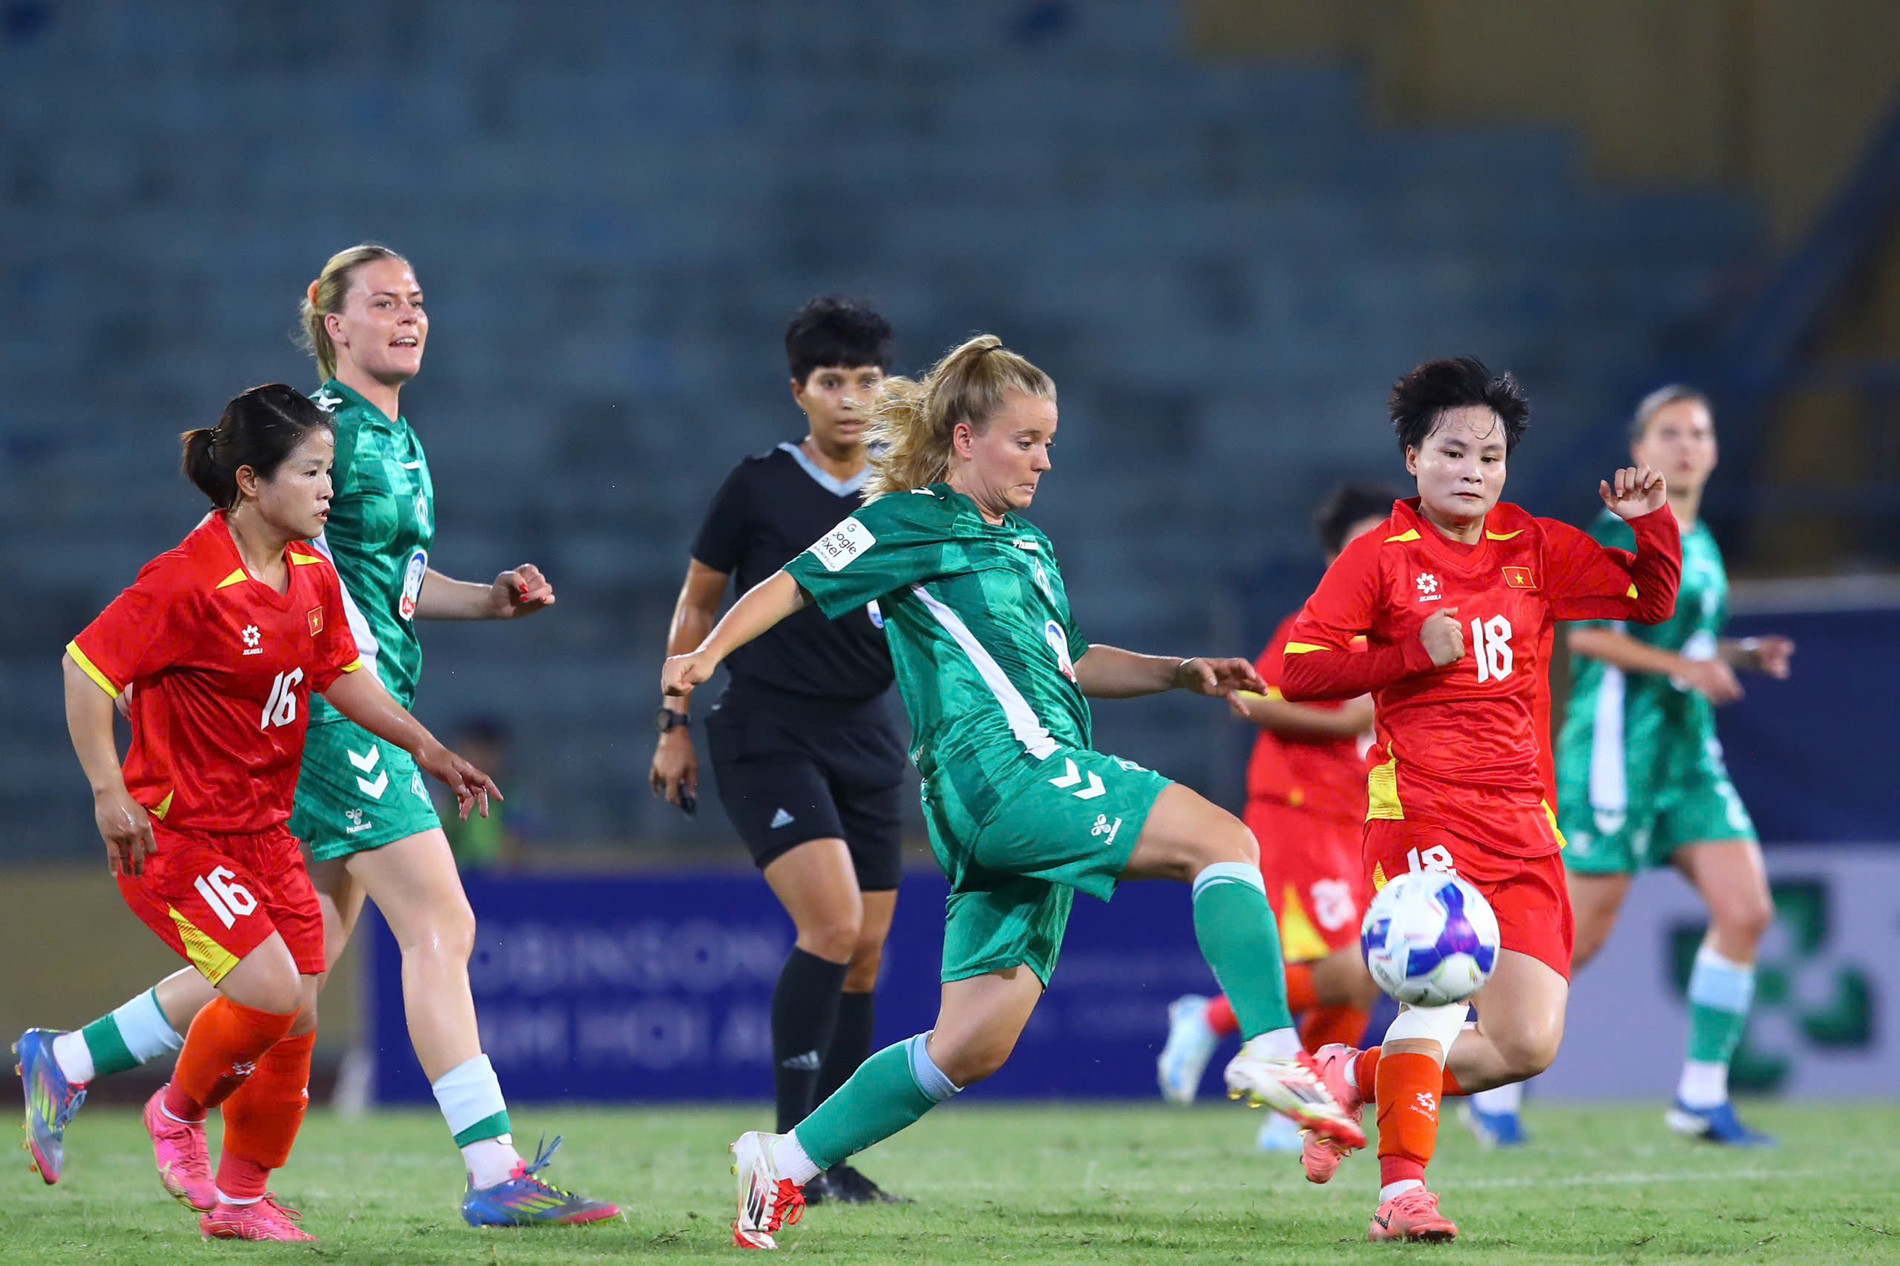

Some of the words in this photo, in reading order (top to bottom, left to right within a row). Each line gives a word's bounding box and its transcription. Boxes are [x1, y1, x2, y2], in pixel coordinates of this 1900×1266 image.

[1471, 614, 1513, 684] 18
[261, 666, 304, 731] 16
[193, 864, 258, 930] 16
[468, 924, 790, 989] OBINSON
